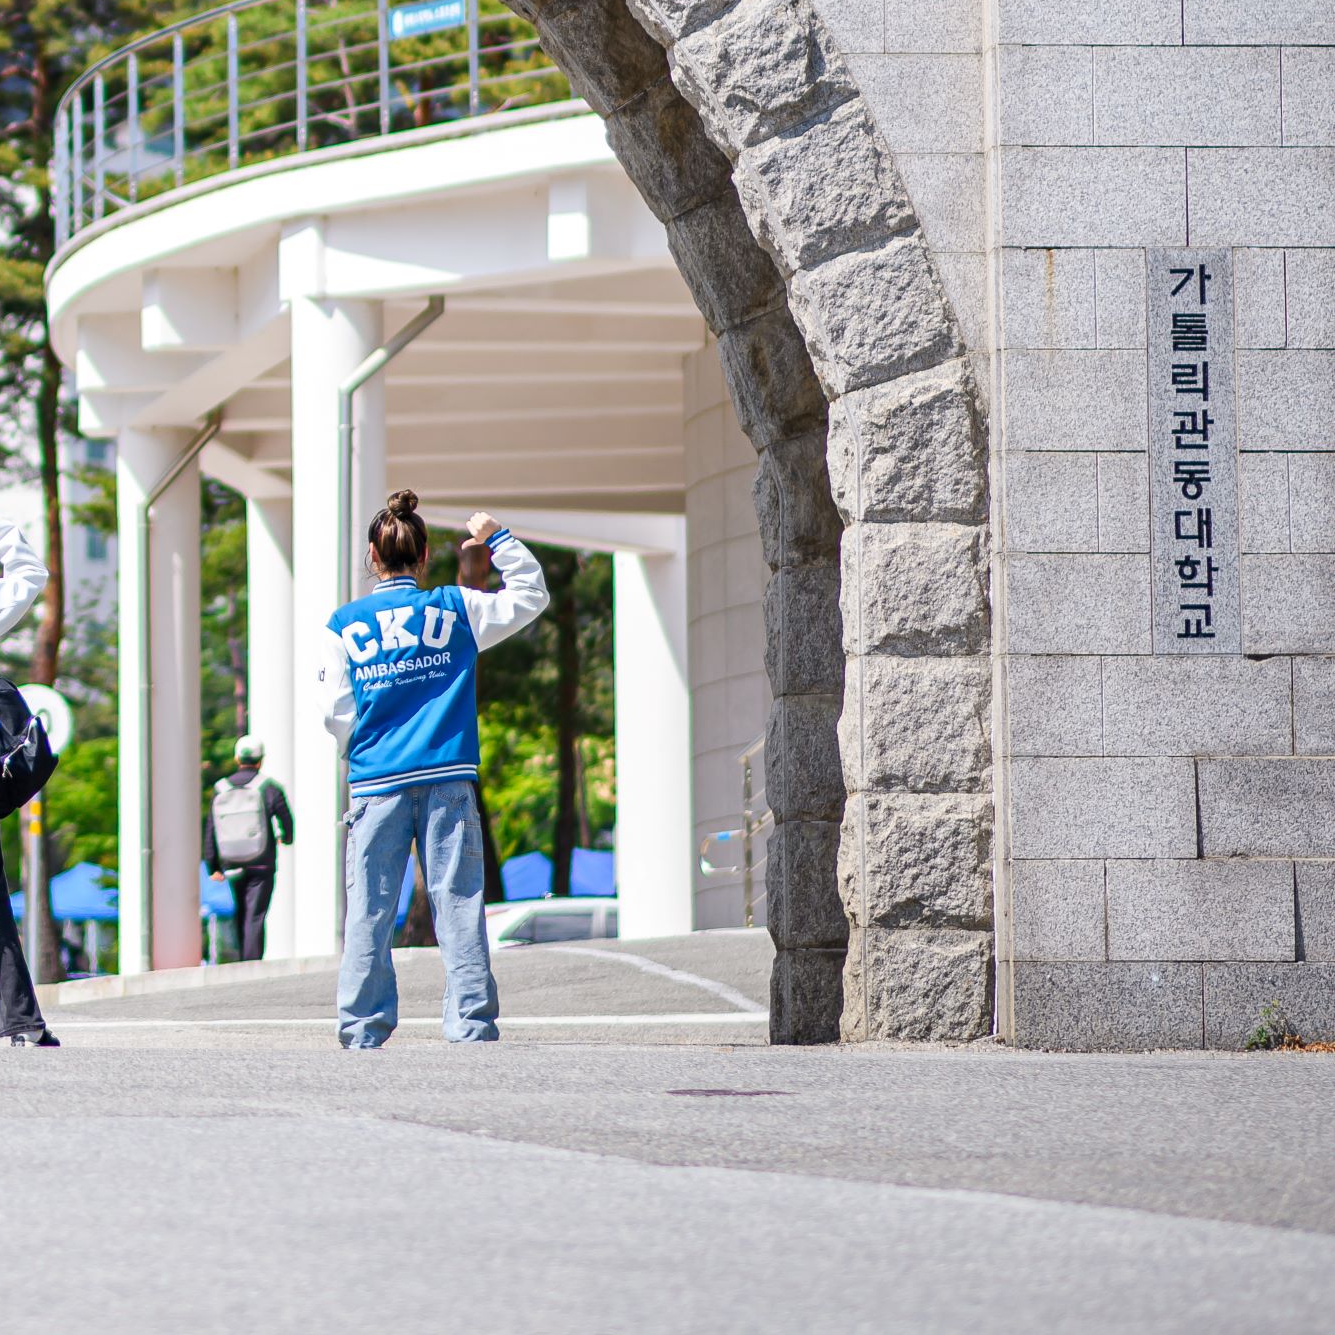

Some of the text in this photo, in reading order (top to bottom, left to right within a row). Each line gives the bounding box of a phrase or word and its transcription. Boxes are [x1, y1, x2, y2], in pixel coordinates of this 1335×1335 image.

[1168, 263, 1219, 640] 가톨릭관동대학교
[341, 605, 457, 663] CKU
[355, 651, 451, 681] AMBASSADOR
